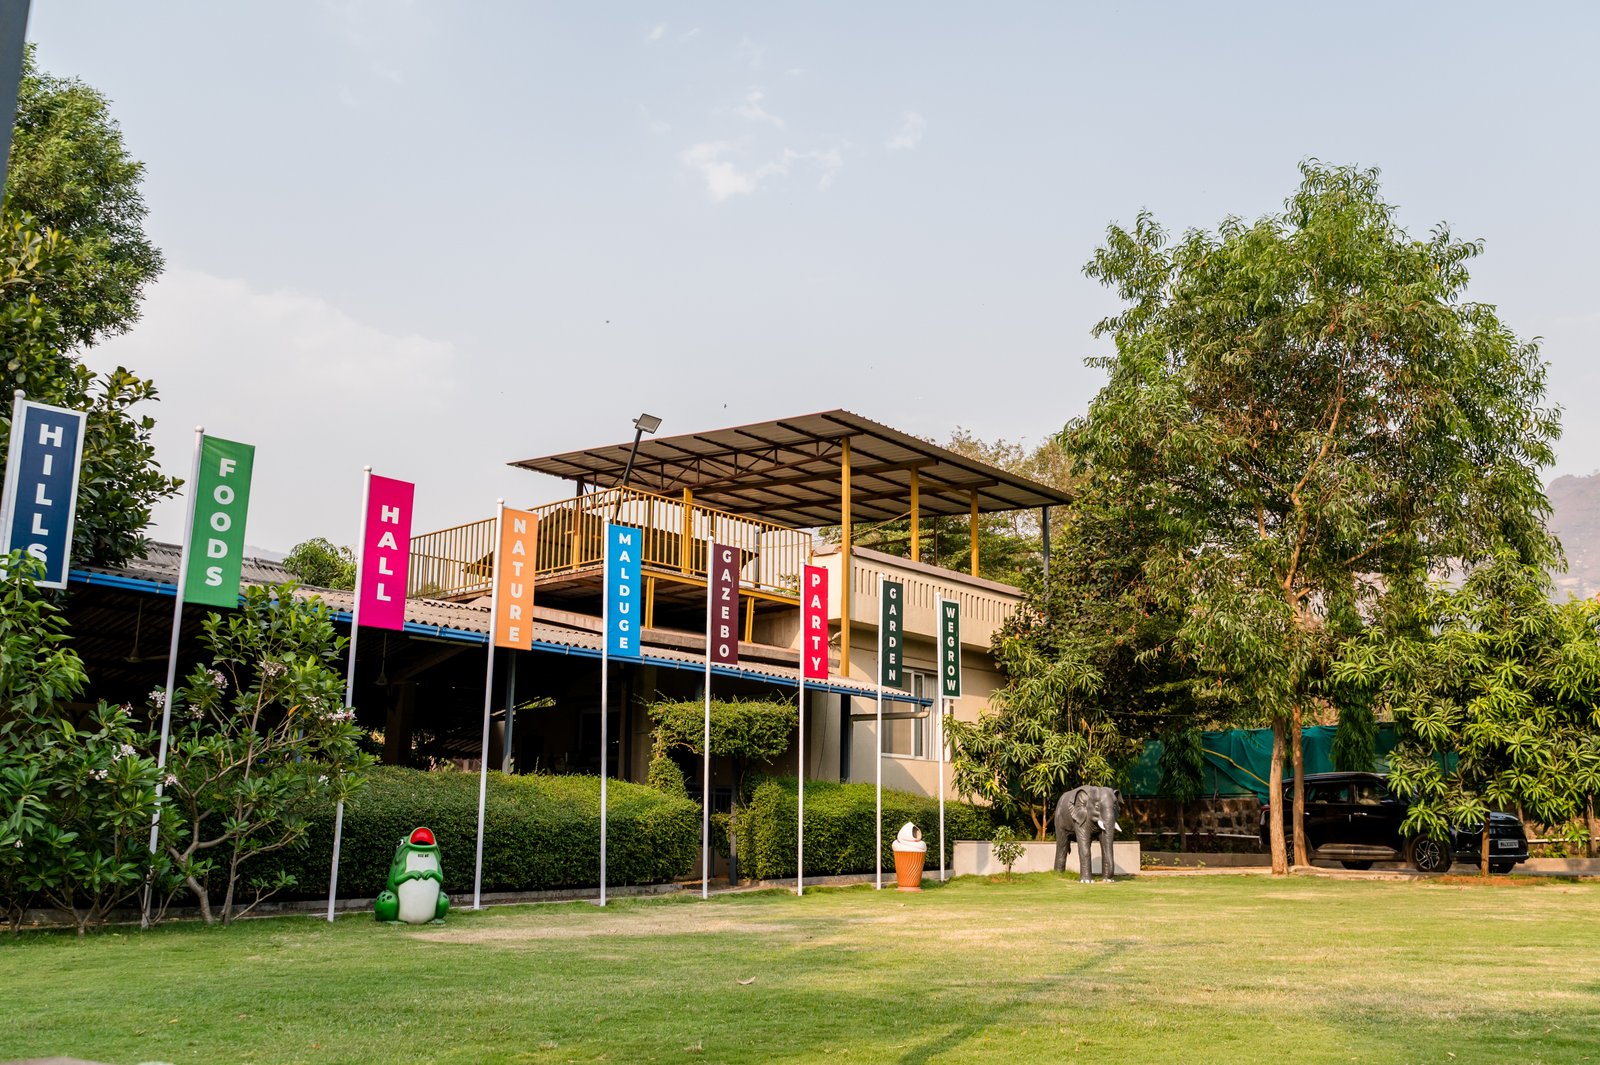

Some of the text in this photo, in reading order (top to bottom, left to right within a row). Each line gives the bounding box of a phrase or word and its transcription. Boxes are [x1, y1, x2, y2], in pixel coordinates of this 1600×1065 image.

[205, 457, 237, 587] FOODS
[376, 504, 400, 602] HALL
[508, 518, 527, 642] NATURE
[618, 532, 632, 649] MALDUGE
[719, 550, 732, 658] GAZEBO
[811, 573, 822, 672] PARTY
[888, 587, 897, 681] GARDEN
[946, 606, 956, 691] WEGROW
